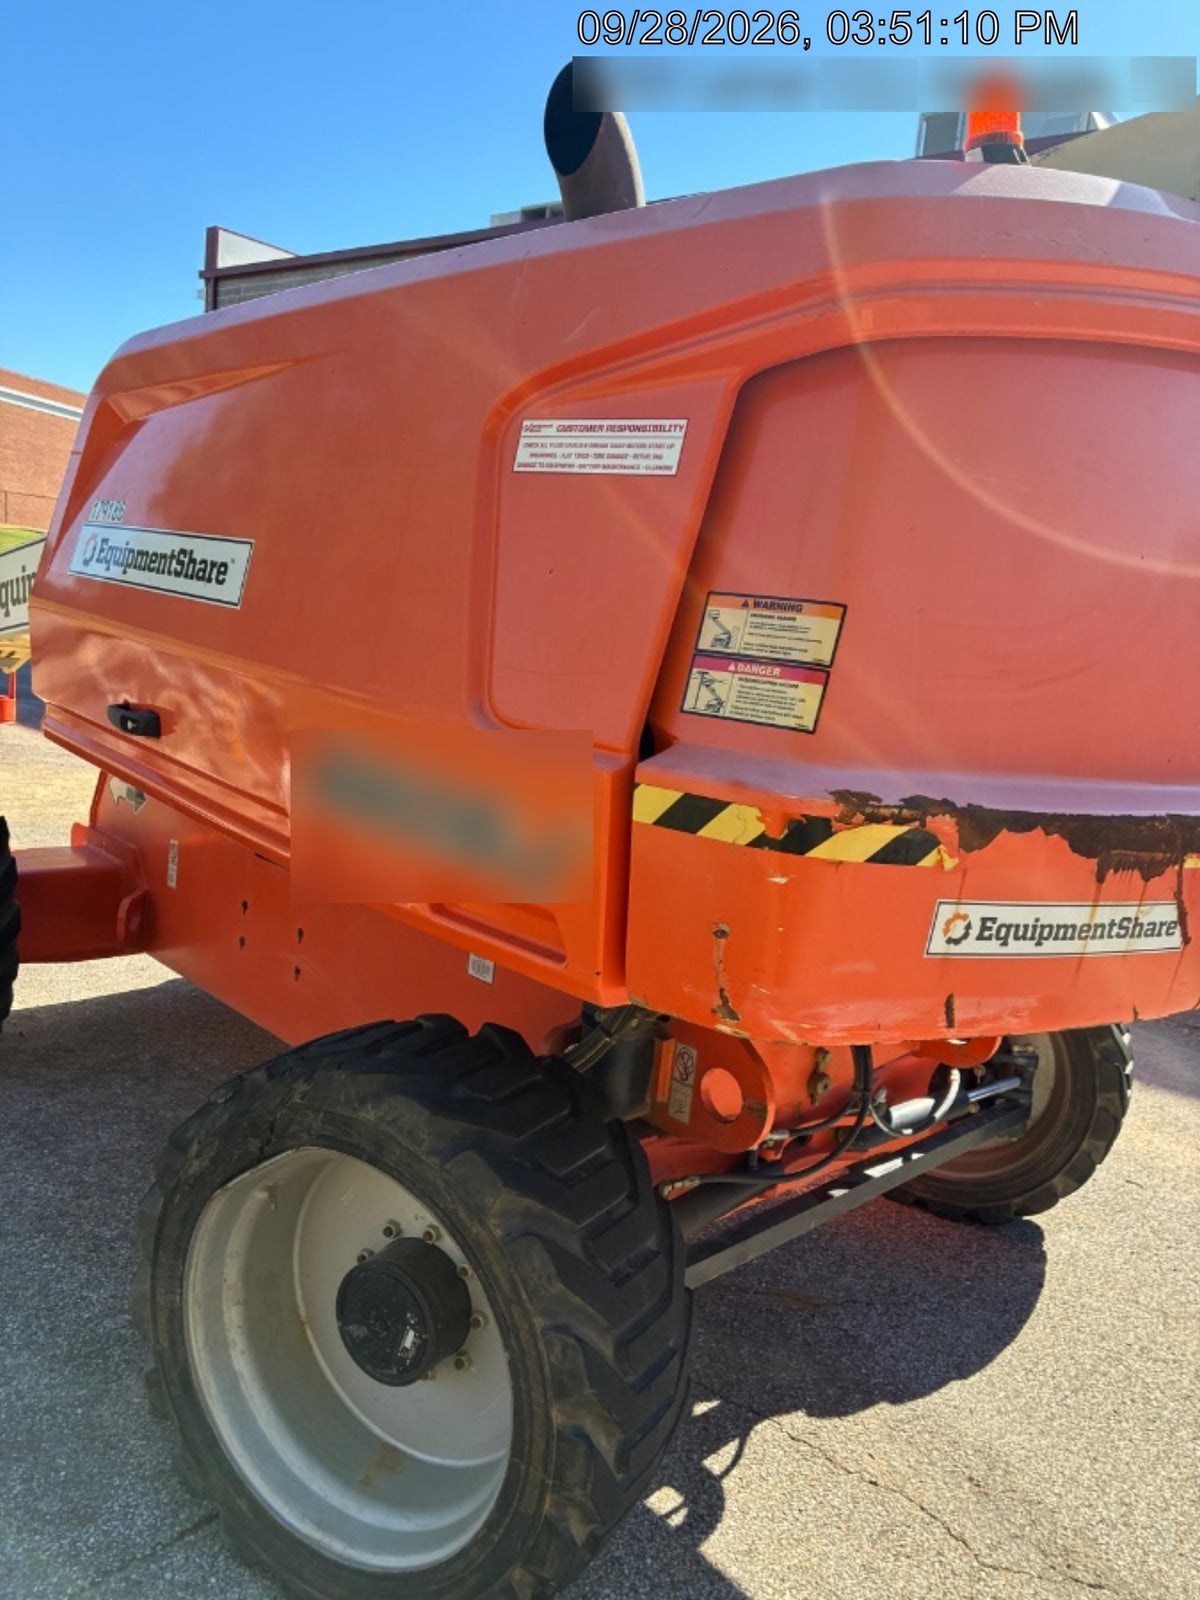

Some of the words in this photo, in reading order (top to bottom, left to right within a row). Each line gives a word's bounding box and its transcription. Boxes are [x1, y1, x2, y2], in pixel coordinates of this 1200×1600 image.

[556, 423, 604, 433] CUSTOMER
[606, 423, 685, 433] RESPONSIBILITY
[753, 599, 804, 613] WARNING
[737, 663, 781, 676] DANGER
[975, 916, 1178, 947] EquipmentShare
